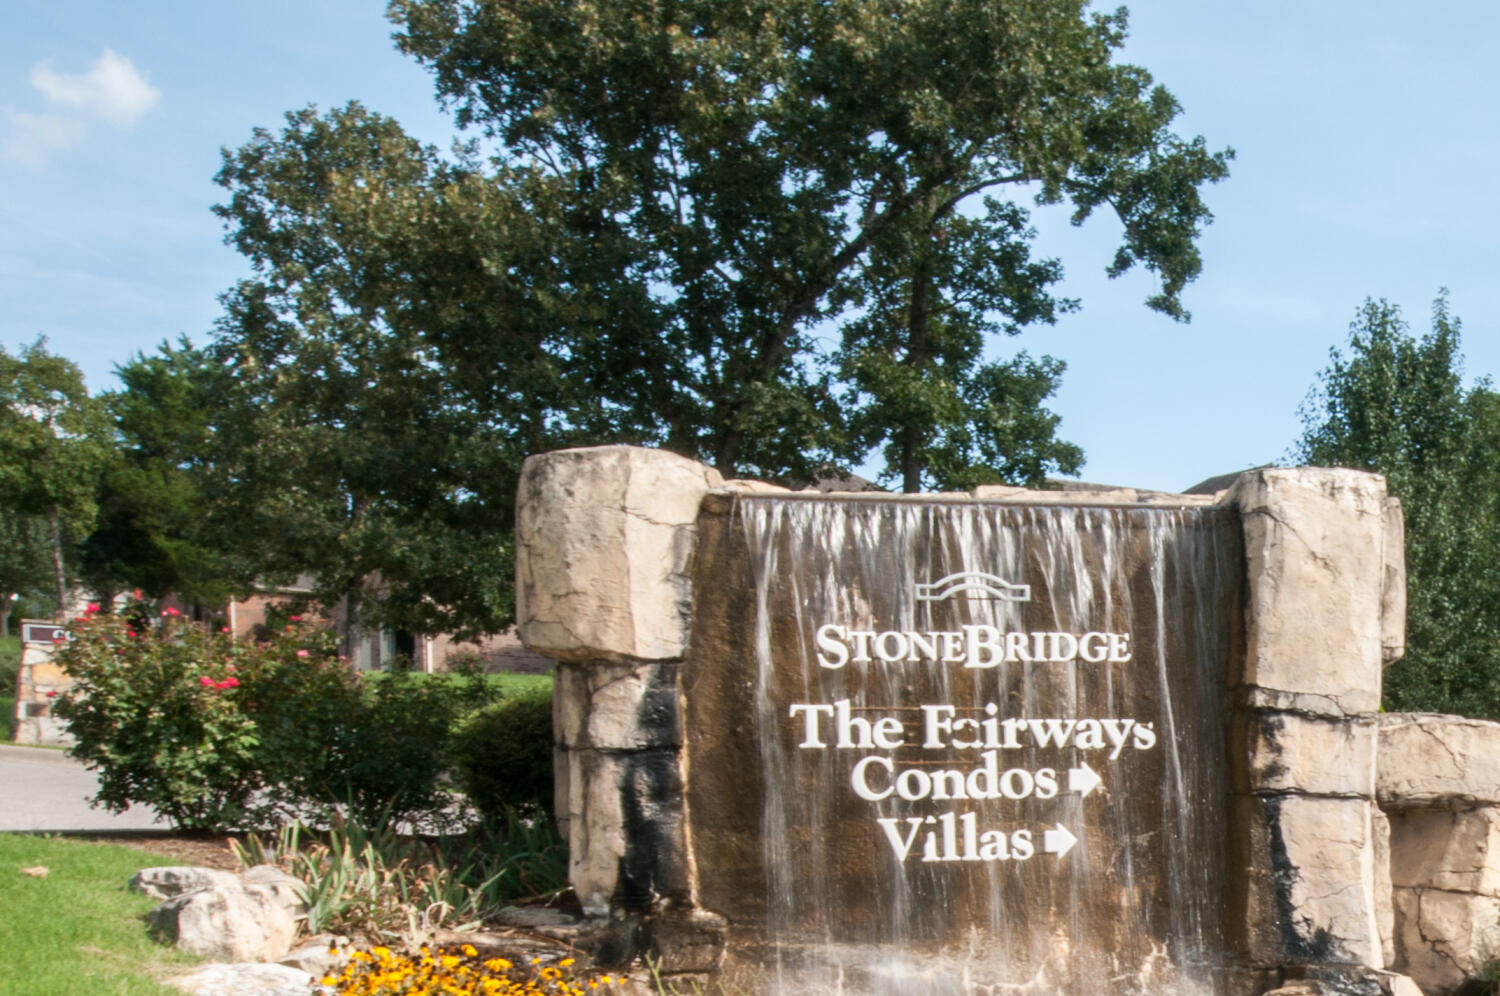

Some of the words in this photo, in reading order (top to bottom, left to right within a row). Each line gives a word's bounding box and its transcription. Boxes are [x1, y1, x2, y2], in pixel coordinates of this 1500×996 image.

[817, 625, 1132, 668] STONEBRIDGE
[790, 700, 904, 749] The
[920, 702, 1156, 760] Fairways
[851, 750, 1059, 801] Condos
[877, 812, 1035, 862] Villas
